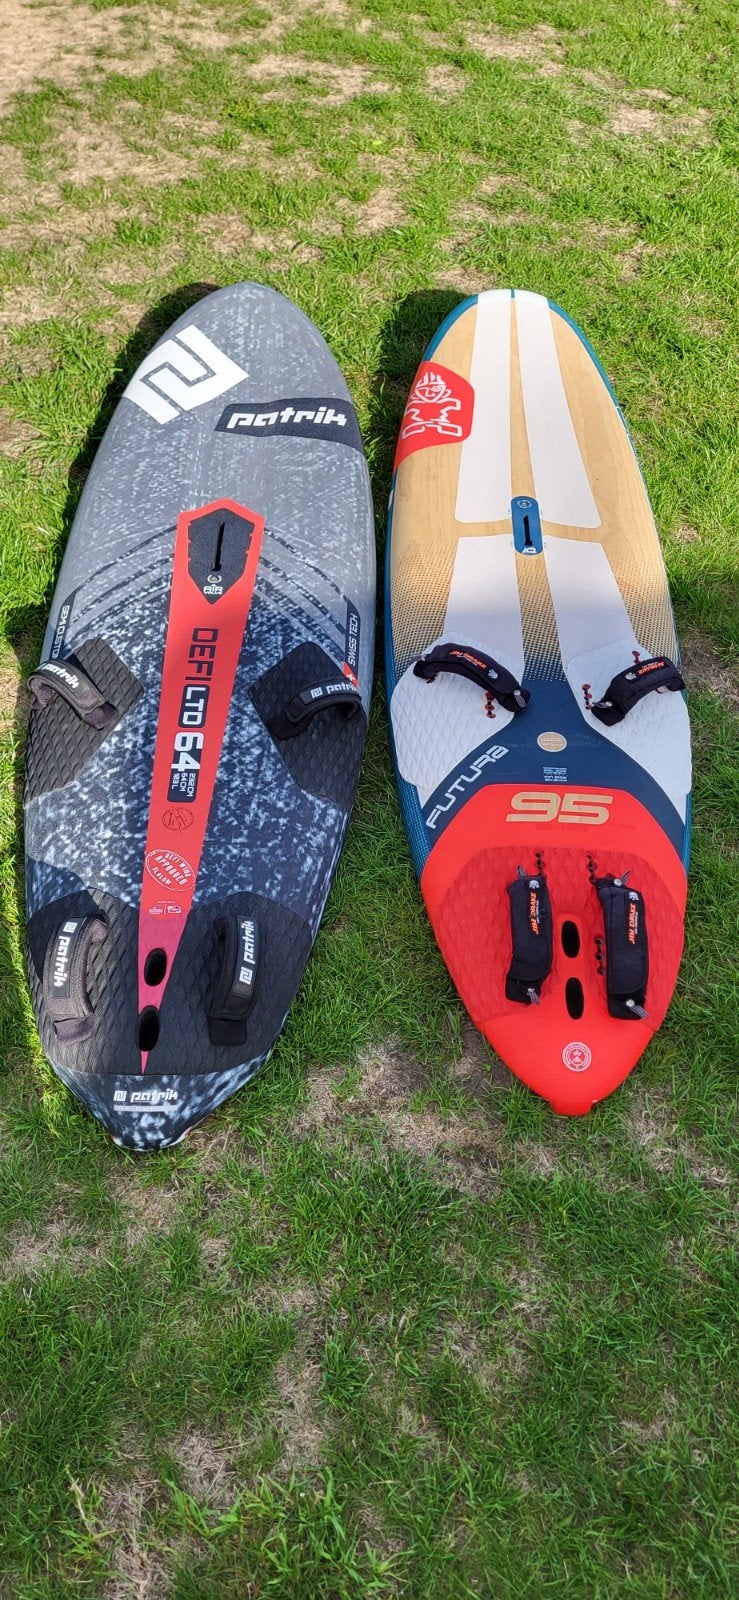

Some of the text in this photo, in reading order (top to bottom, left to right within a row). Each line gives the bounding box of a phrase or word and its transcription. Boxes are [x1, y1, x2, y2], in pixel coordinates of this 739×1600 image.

[226, 406, 347, 428] patrik
[185, 628, 219, 681] DEFI
[347, 613, 358, 666] SWISS TECH
[182, 687, 206, 725] LTD
[171, 732, 204, 772] 64
[426, 745, 509, 829] FUTURA
[506, 792, 613, 824] 95
[155, 855, 187, 885] APPROVED
[54, 936, 70, 986] patrik
[241, 921, 256, 964] patrik
[130, 1088, 178, 1103] patrik
